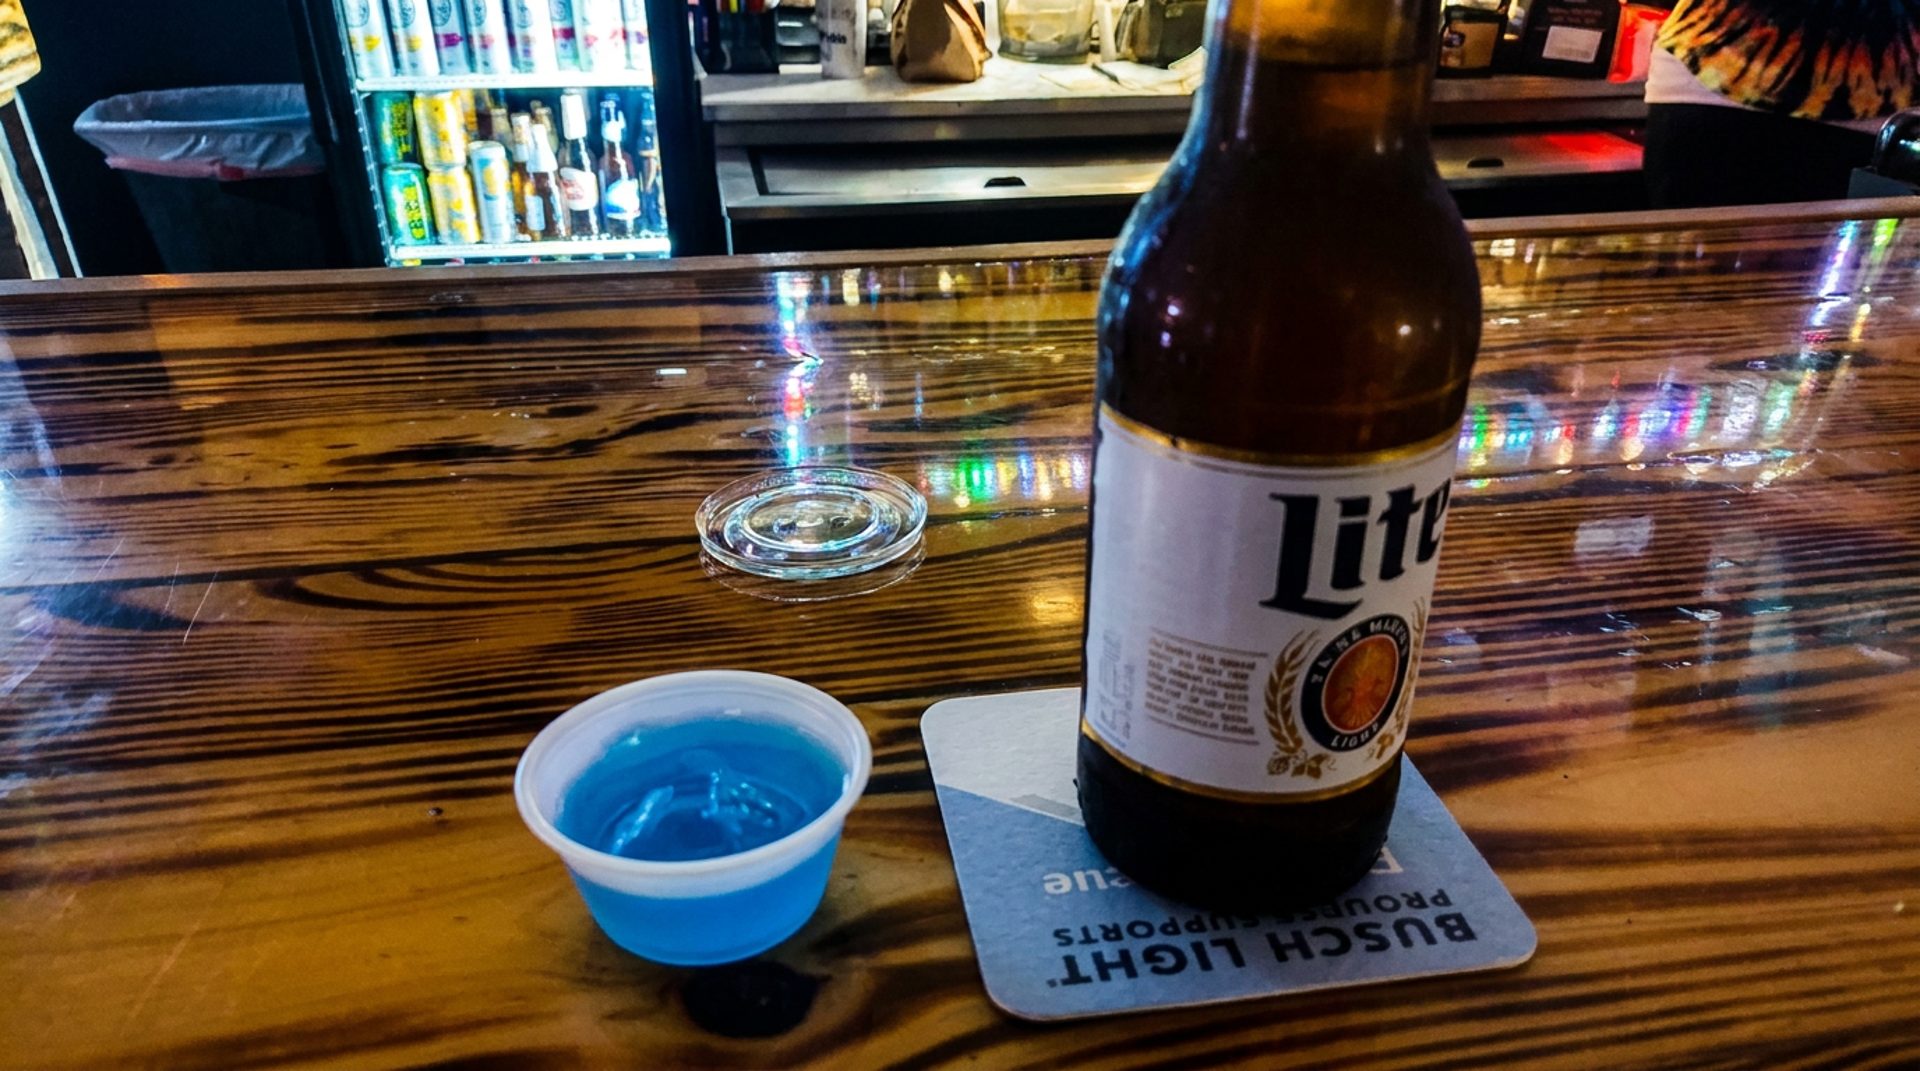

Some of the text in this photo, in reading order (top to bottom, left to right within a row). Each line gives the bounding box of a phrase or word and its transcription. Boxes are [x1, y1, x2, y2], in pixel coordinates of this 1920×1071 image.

[1258, 478, 1451, 620] Lite
[1053, 908, 1260, 947] SUPPORTS
[1059, 912, 1478, 987] BUSCH LIGHT
